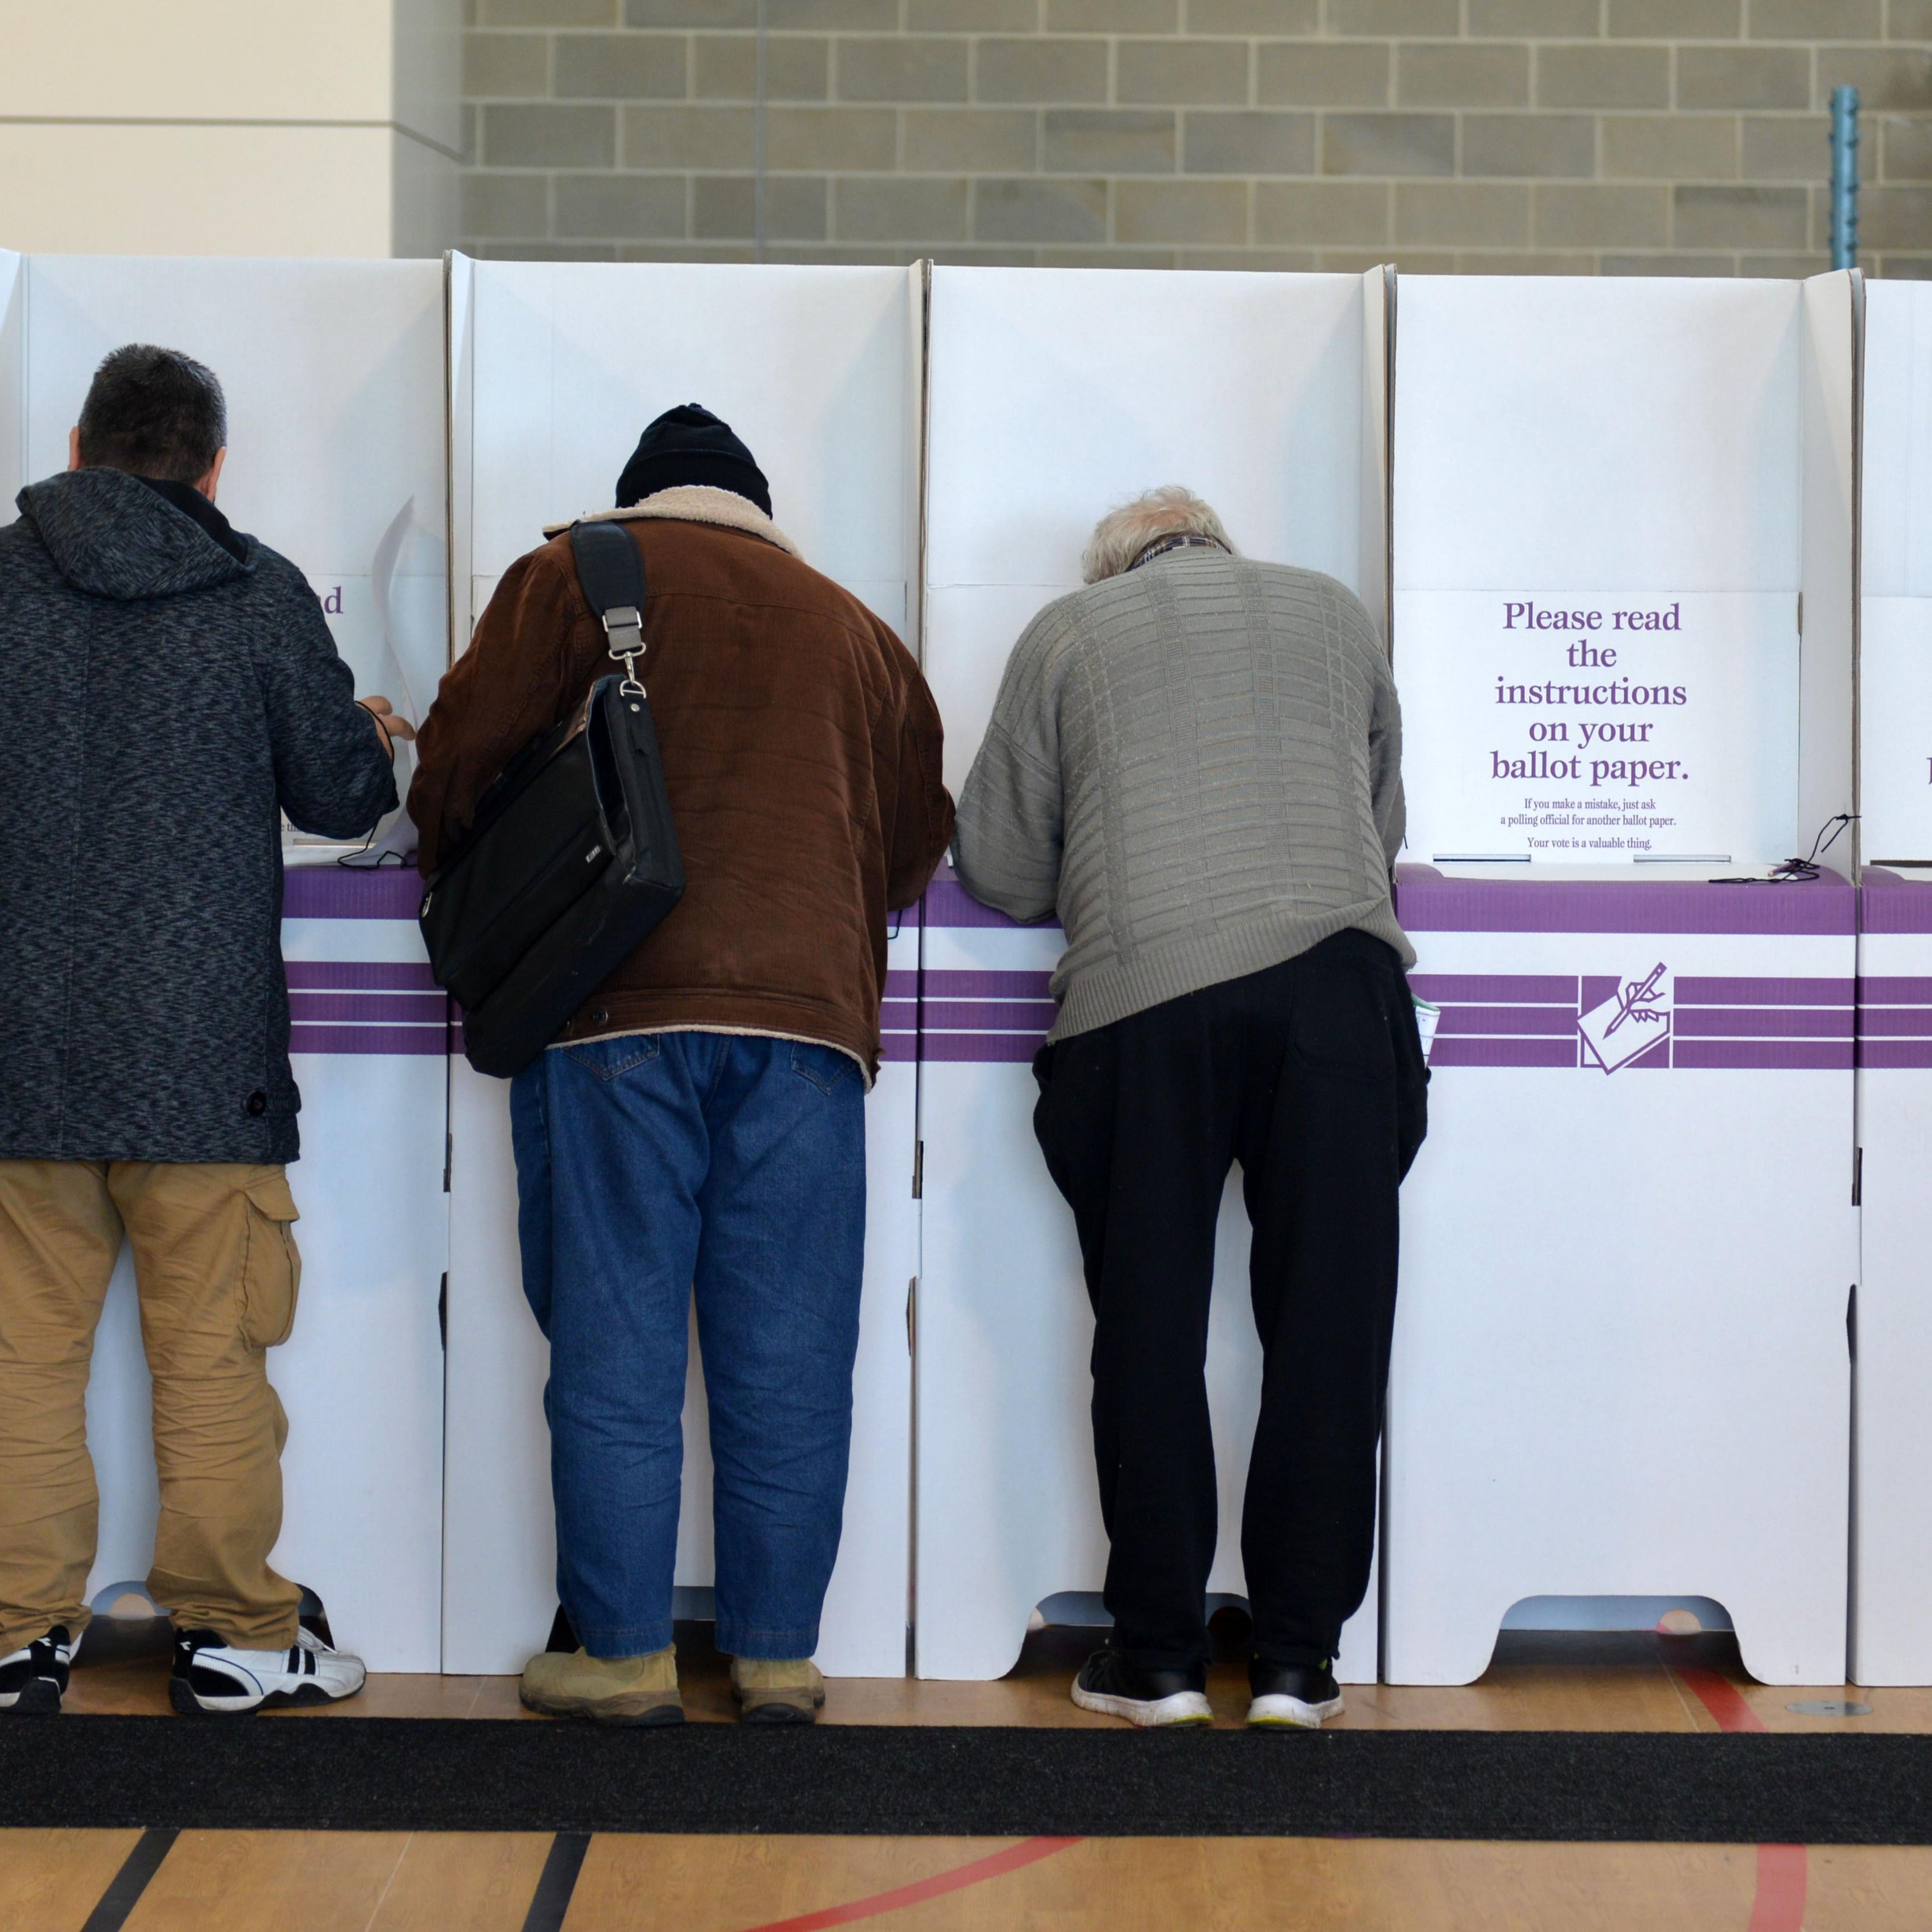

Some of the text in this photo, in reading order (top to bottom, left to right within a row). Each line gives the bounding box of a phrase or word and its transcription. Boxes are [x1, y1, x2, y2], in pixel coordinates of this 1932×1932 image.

[1503, 601, 1682, 631] Please read
[1566, 638, 1617, 668] the
[1495, 676, 1687, 705] instructions
[1529, 722, 1654, 749] on your
[1489, 750, 1688, 787] ballot paper.
[1524, 798, 1656, 812] If you make a mistake, just ask
[1500, 814, 1677, 828] a polling official for another ballot paper.
[1527, 837, 1652, 851] Your vote is a valuable thing.
